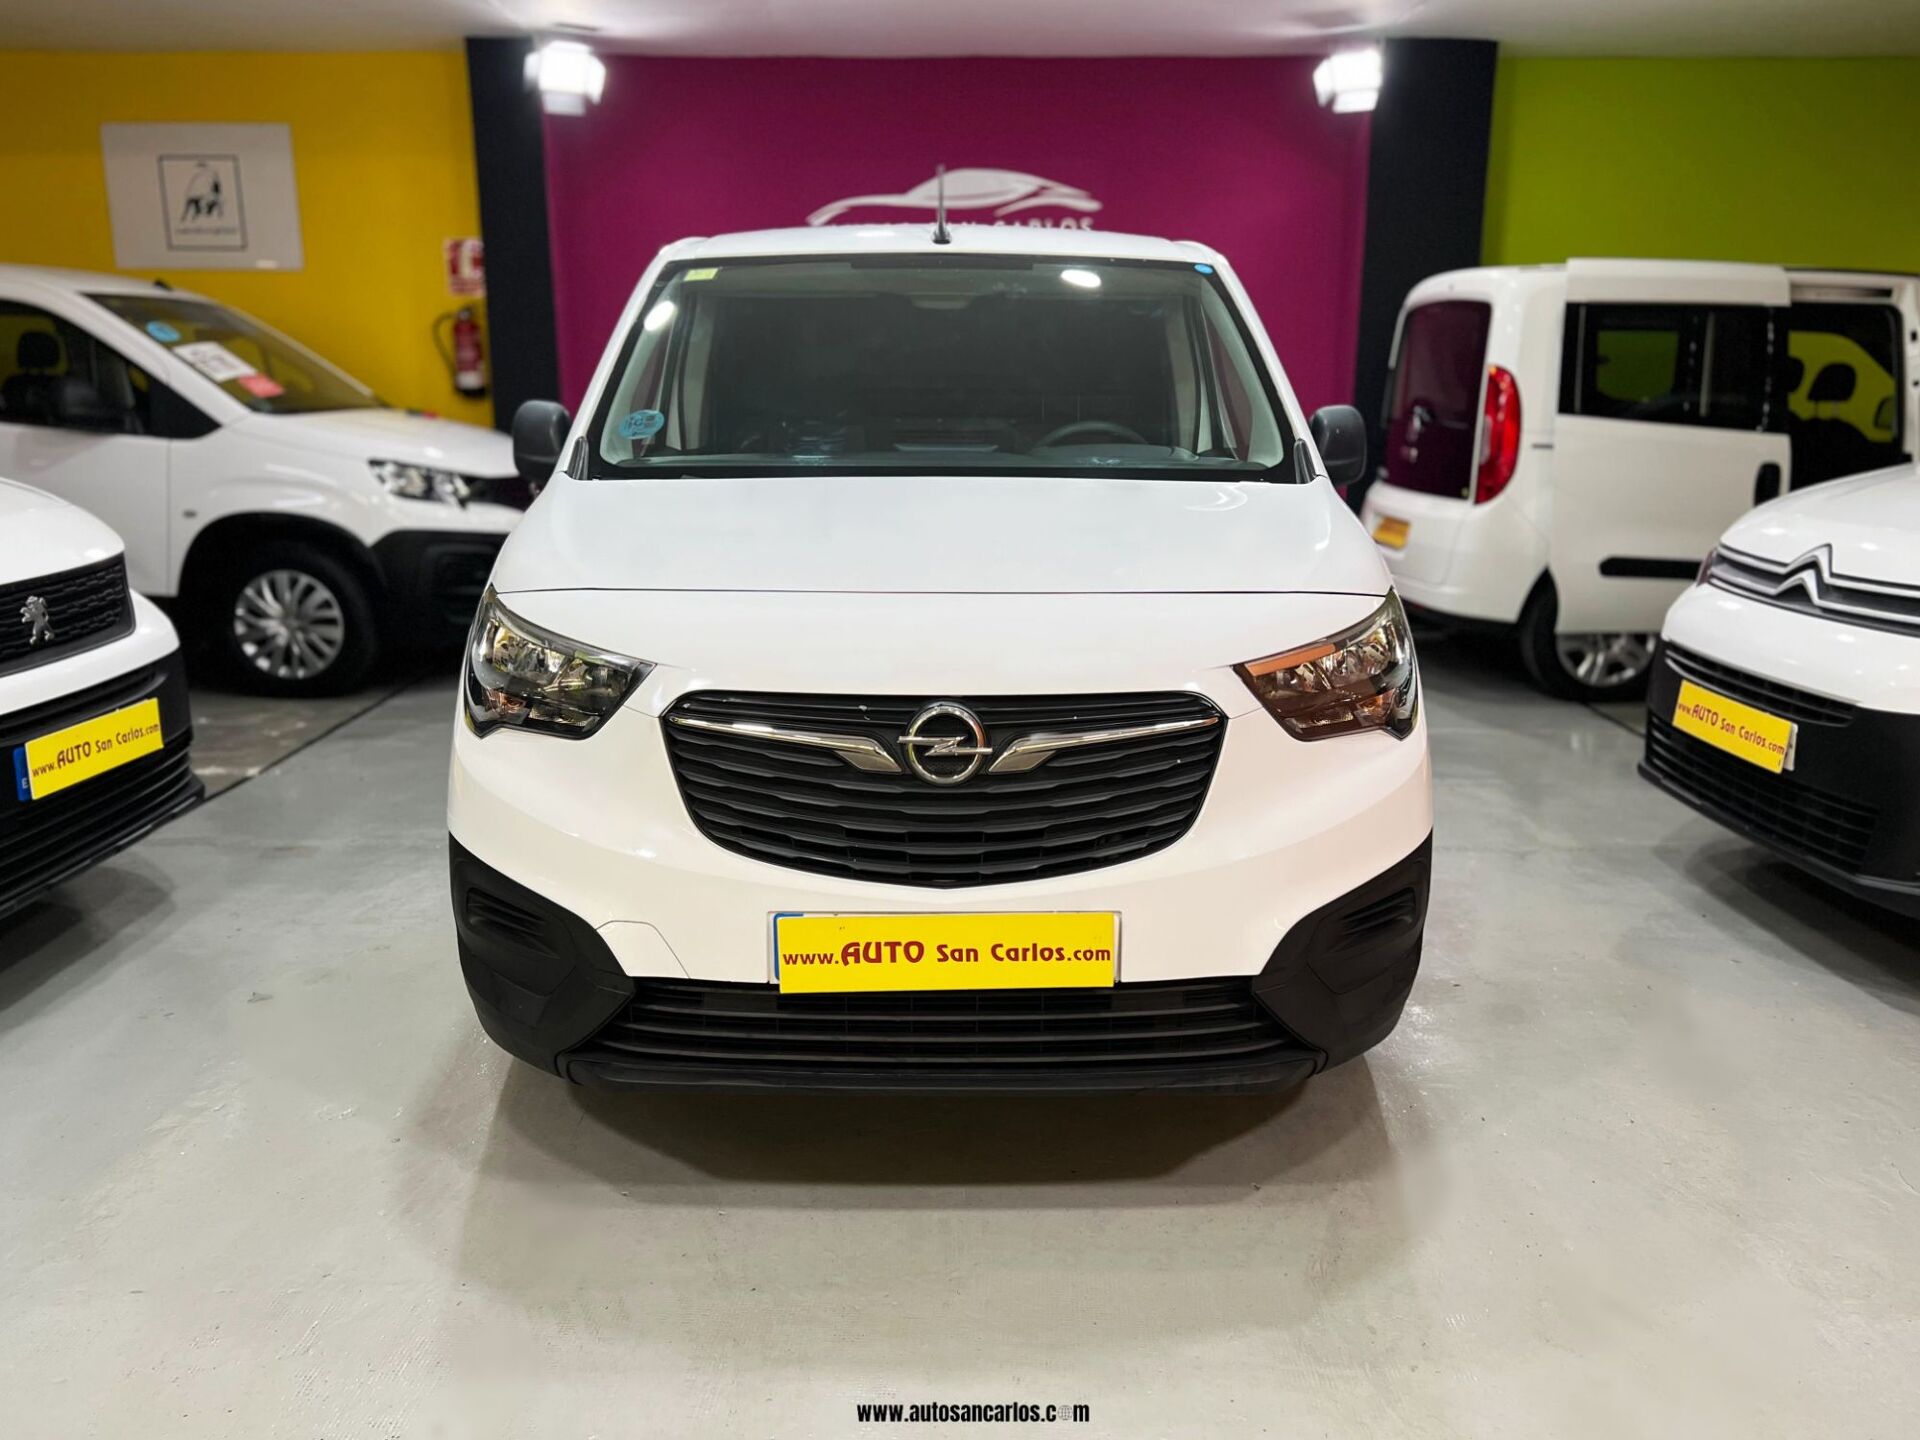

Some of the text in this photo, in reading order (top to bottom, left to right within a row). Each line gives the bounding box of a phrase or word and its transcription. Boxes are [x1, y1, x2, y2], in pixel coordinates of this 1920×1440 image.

[32, 723, 159, 777] www.AUTO San Carlos.com
[1720, 718, 1736, 735] San
[1738, 725, 1785, 755] Carlos.com
[783, 941, 1111, 966] www.AUTO San Carlos.com
